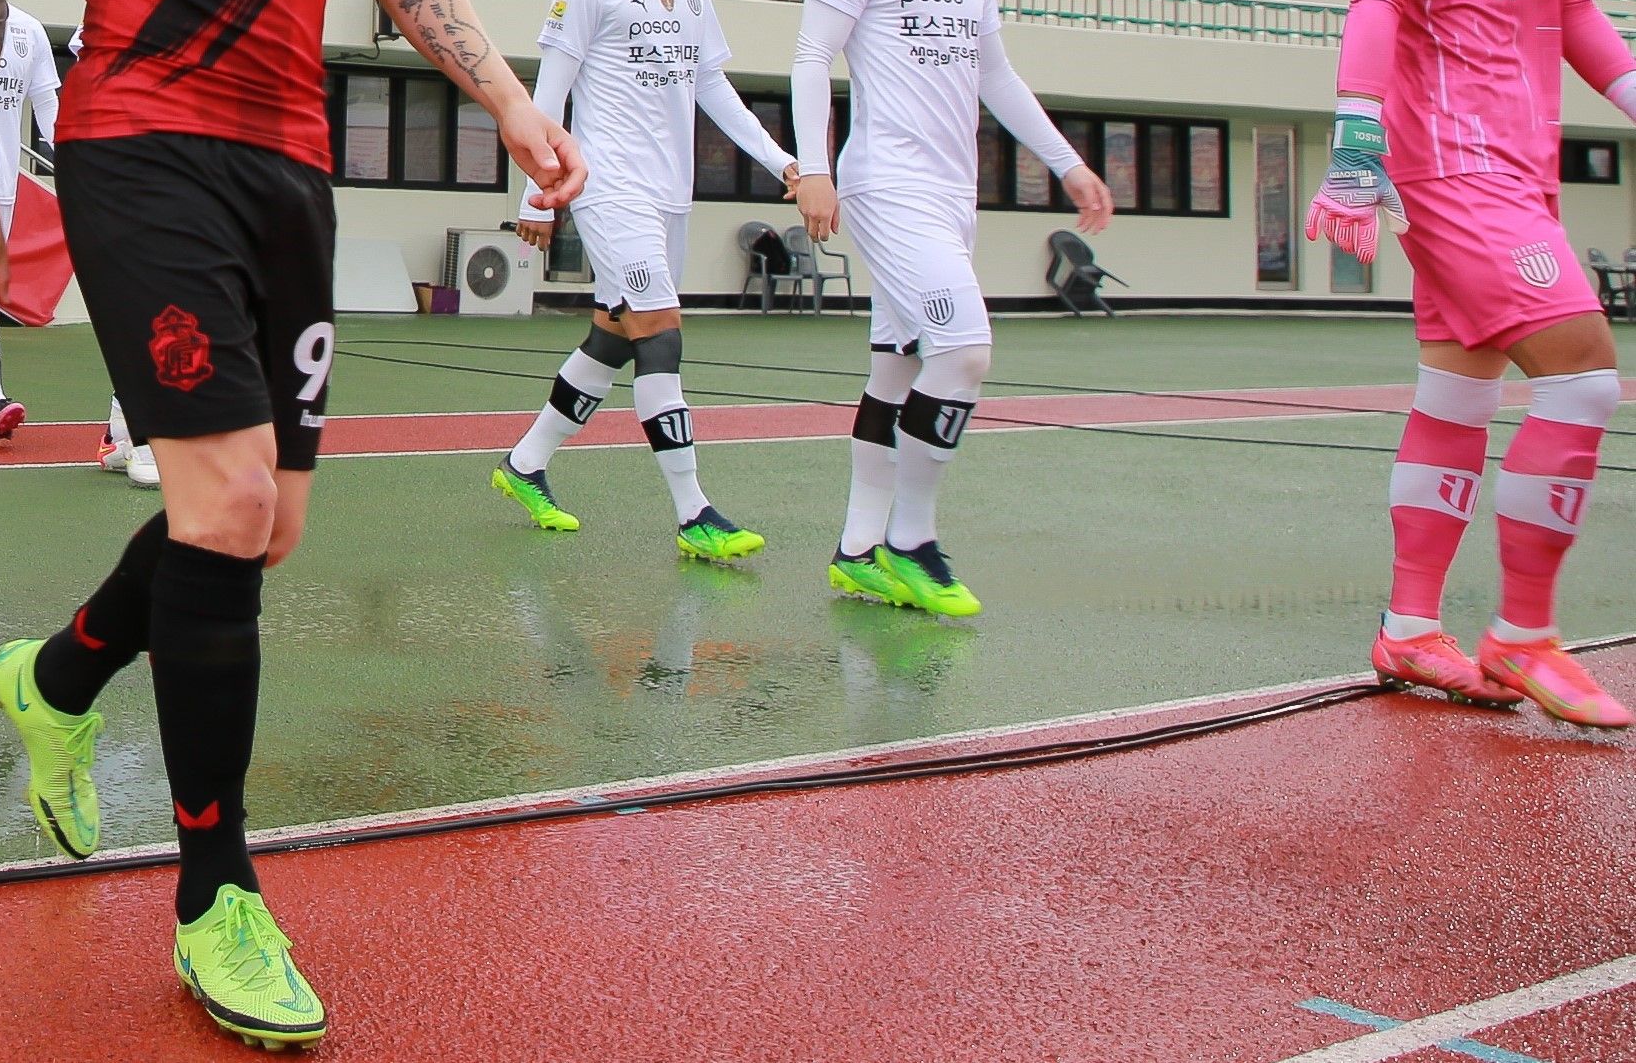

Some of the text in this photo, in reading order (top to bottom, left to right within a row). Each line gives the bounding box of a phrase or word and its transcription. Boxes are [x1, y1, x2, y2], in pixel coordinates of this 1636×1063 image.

[629, 20, 681, 39] posco
[517, 261, 529, 269] LG
[293, 321, 336, 401] 9
